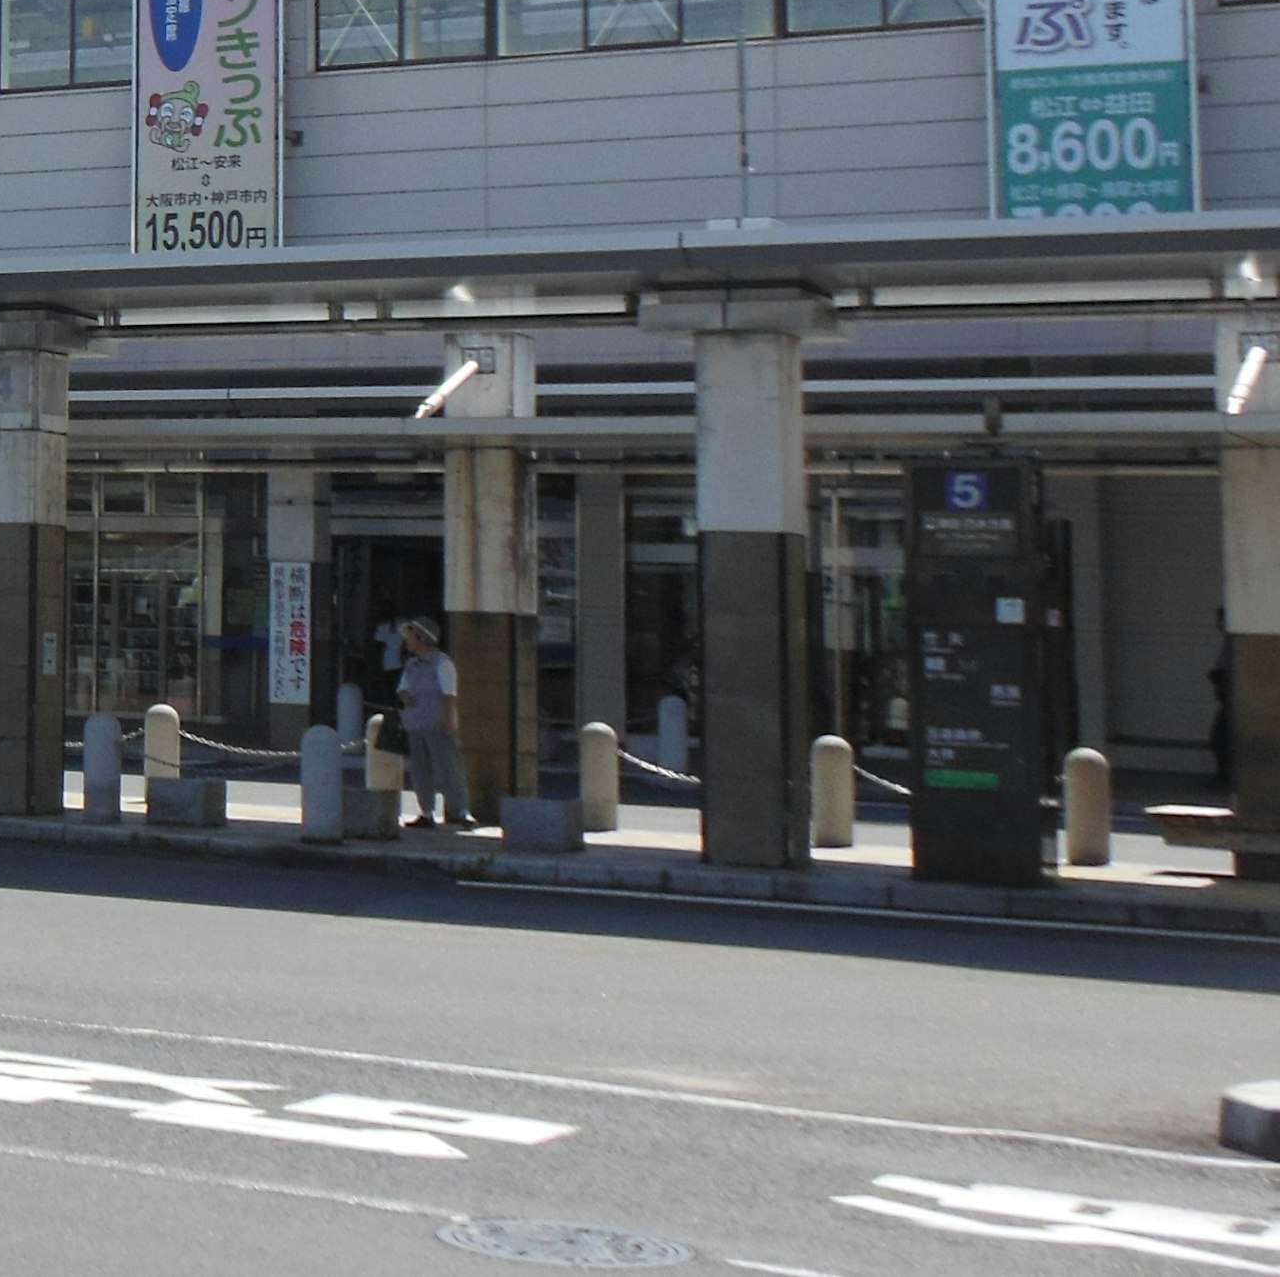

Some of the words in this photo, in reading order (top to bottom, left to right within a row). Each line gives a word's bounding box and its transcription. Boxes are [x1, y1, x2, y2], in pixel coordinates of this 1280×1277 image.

[1007, 118, 1180, 175] 8,600円
[145, 209, 267, 252] 15,500円
[951, 474, 982, 509] 5
[289, 567, 307, 691] 横断は危険です
